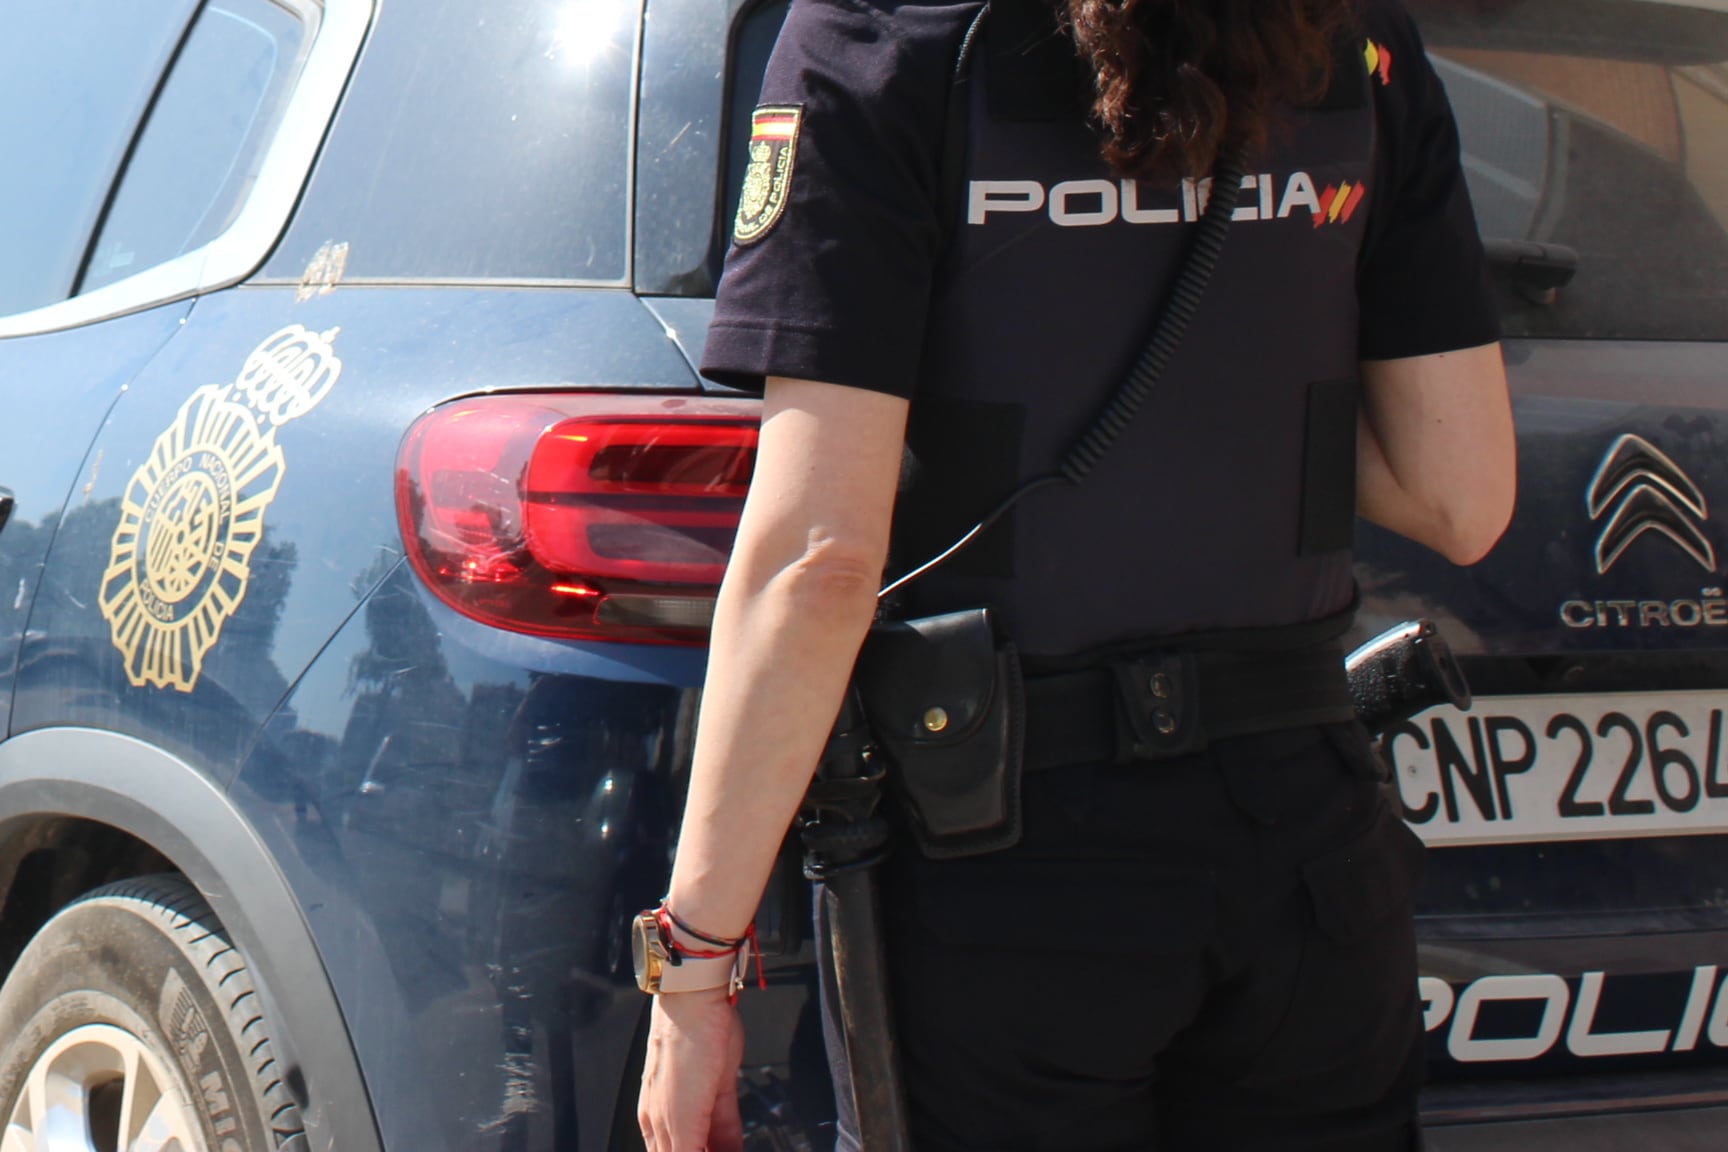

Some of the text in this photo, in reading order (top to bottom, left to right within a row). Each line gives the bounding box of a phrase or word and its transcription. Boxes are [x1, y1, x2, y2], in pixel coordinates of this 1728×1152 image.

[145, 456, 193, 523] CUERPO
[198, 453, 230, 525] NACIONAL
[208, 541, 225, 572] DE
